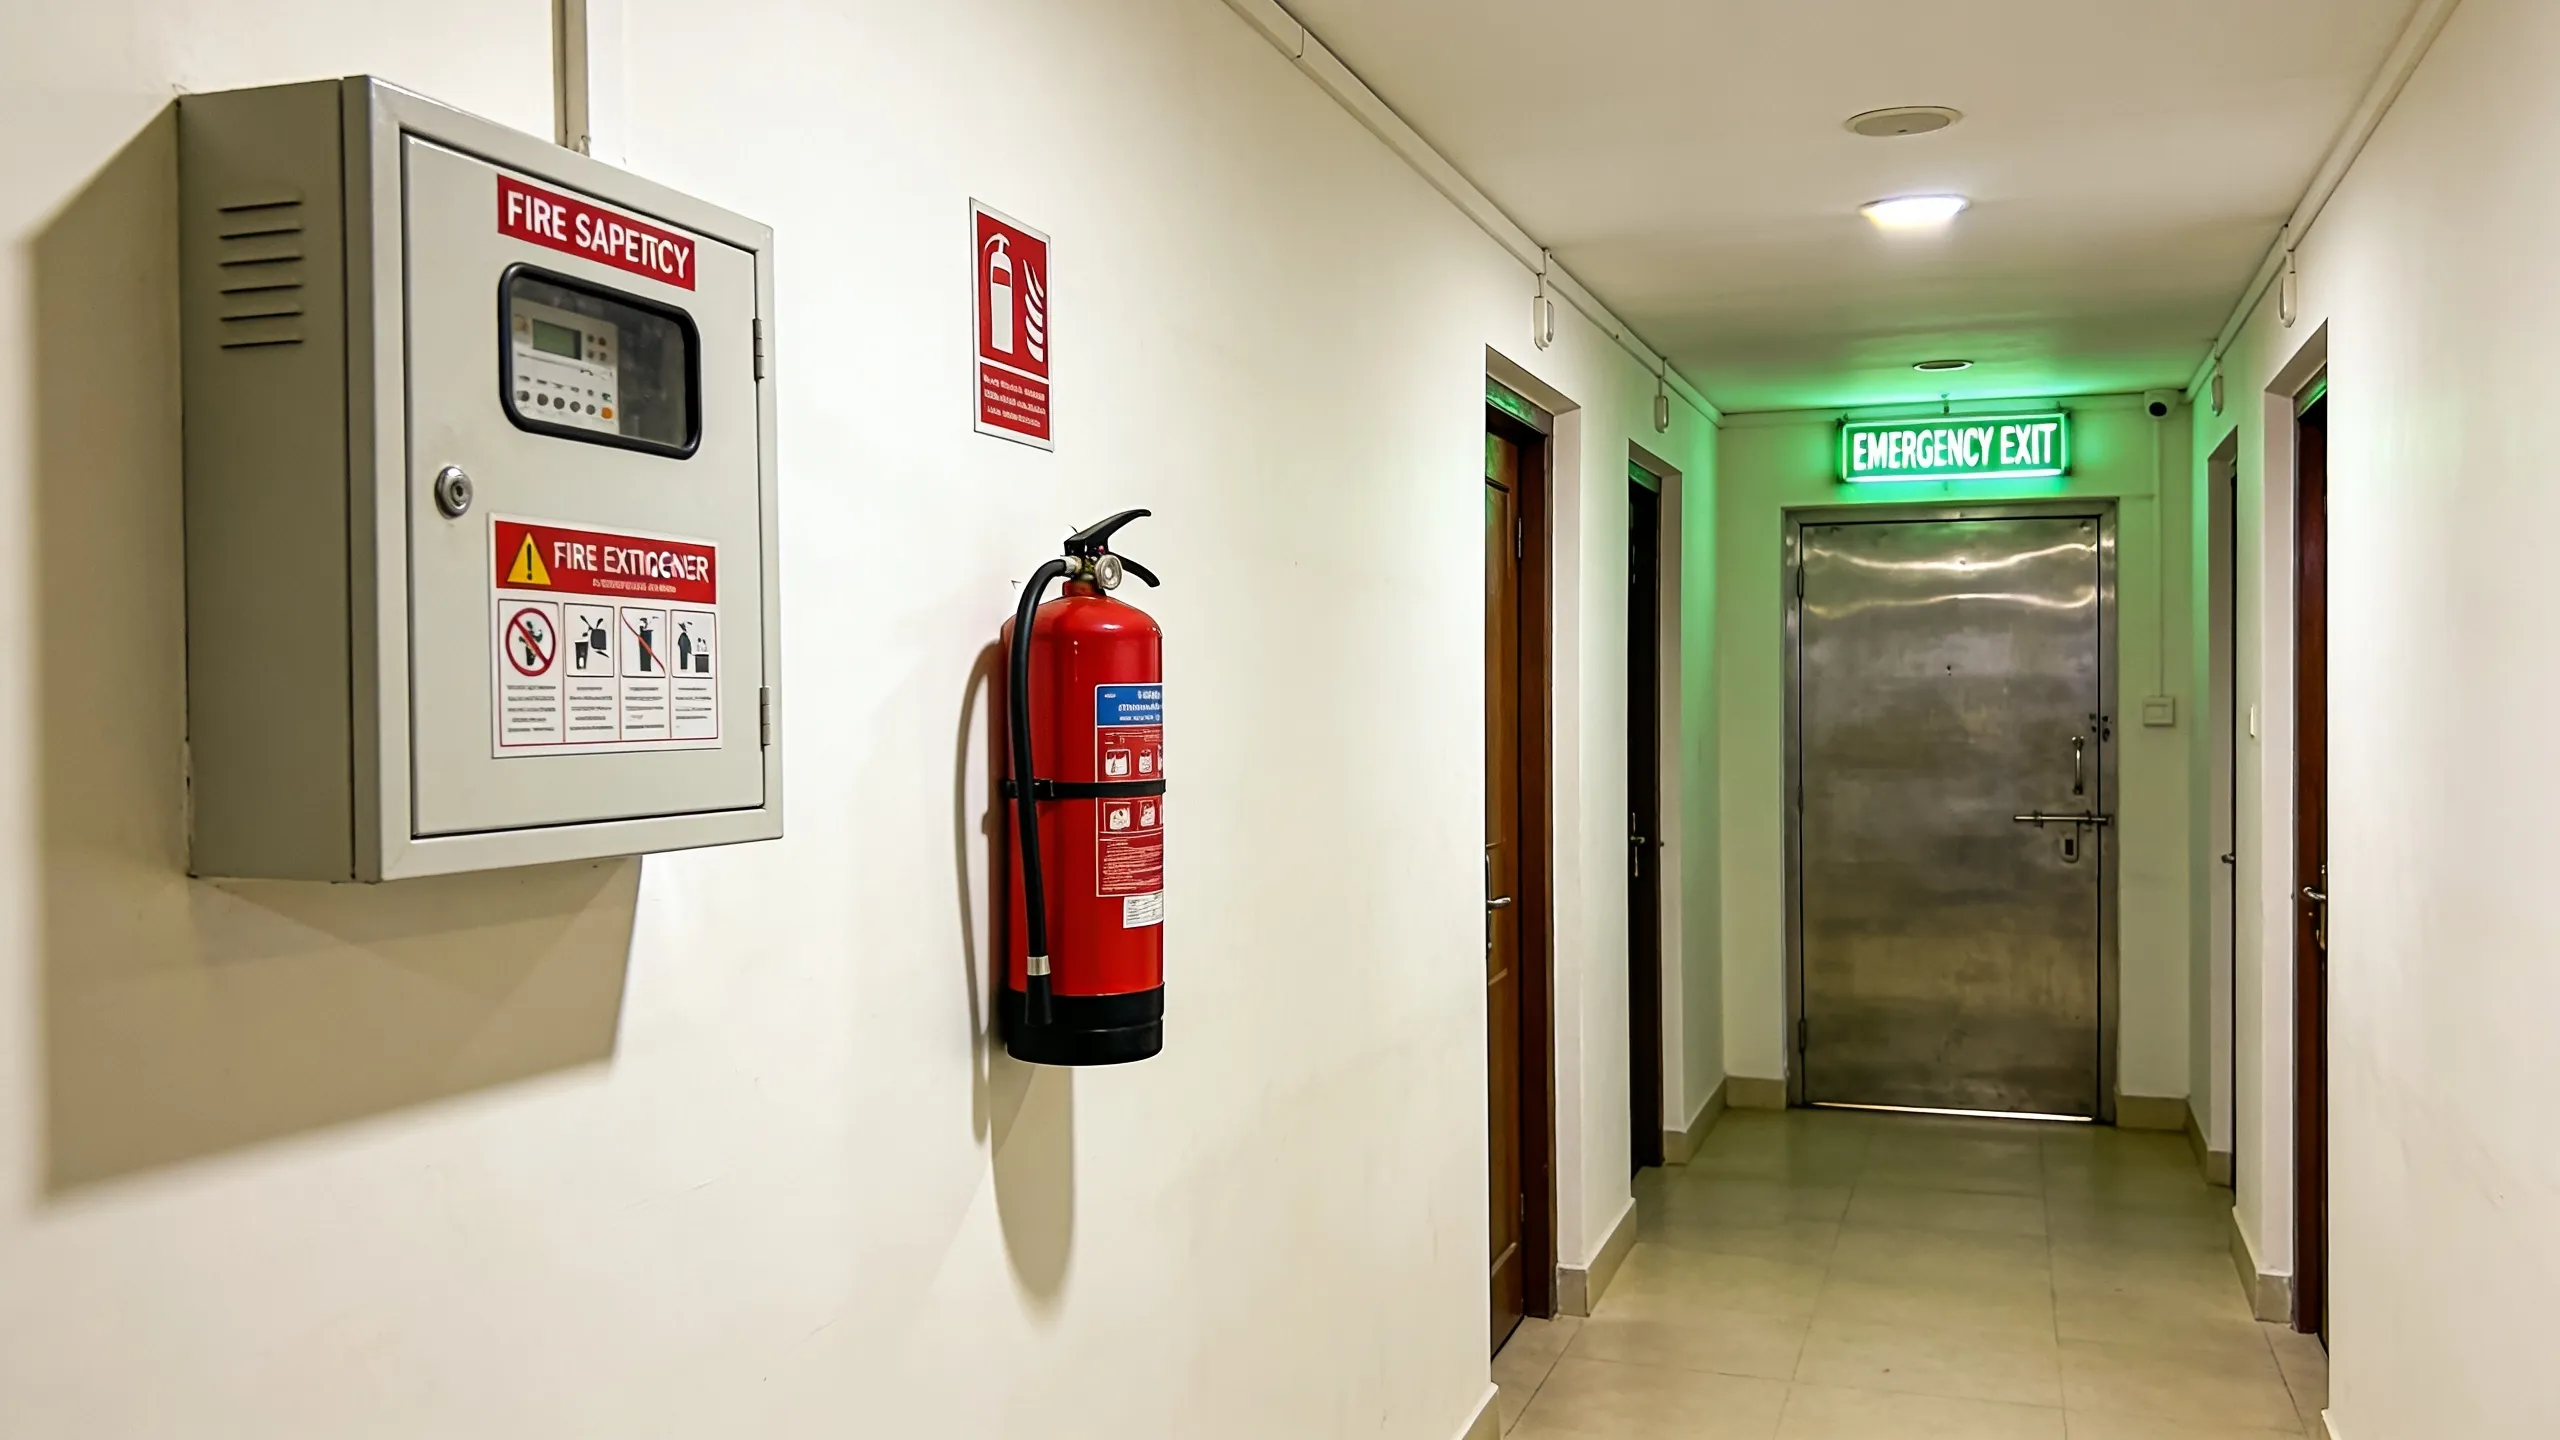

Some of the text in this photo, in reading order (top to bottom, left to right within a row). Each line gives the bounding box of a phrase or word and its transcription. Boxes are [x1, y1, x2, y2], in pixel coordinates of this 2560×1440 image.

[507, 190, 568, 241] FIRE
[1853, 423, 2058, 471] EMERGENCY EXIT
[553, 541, 598, 572] FIRE
